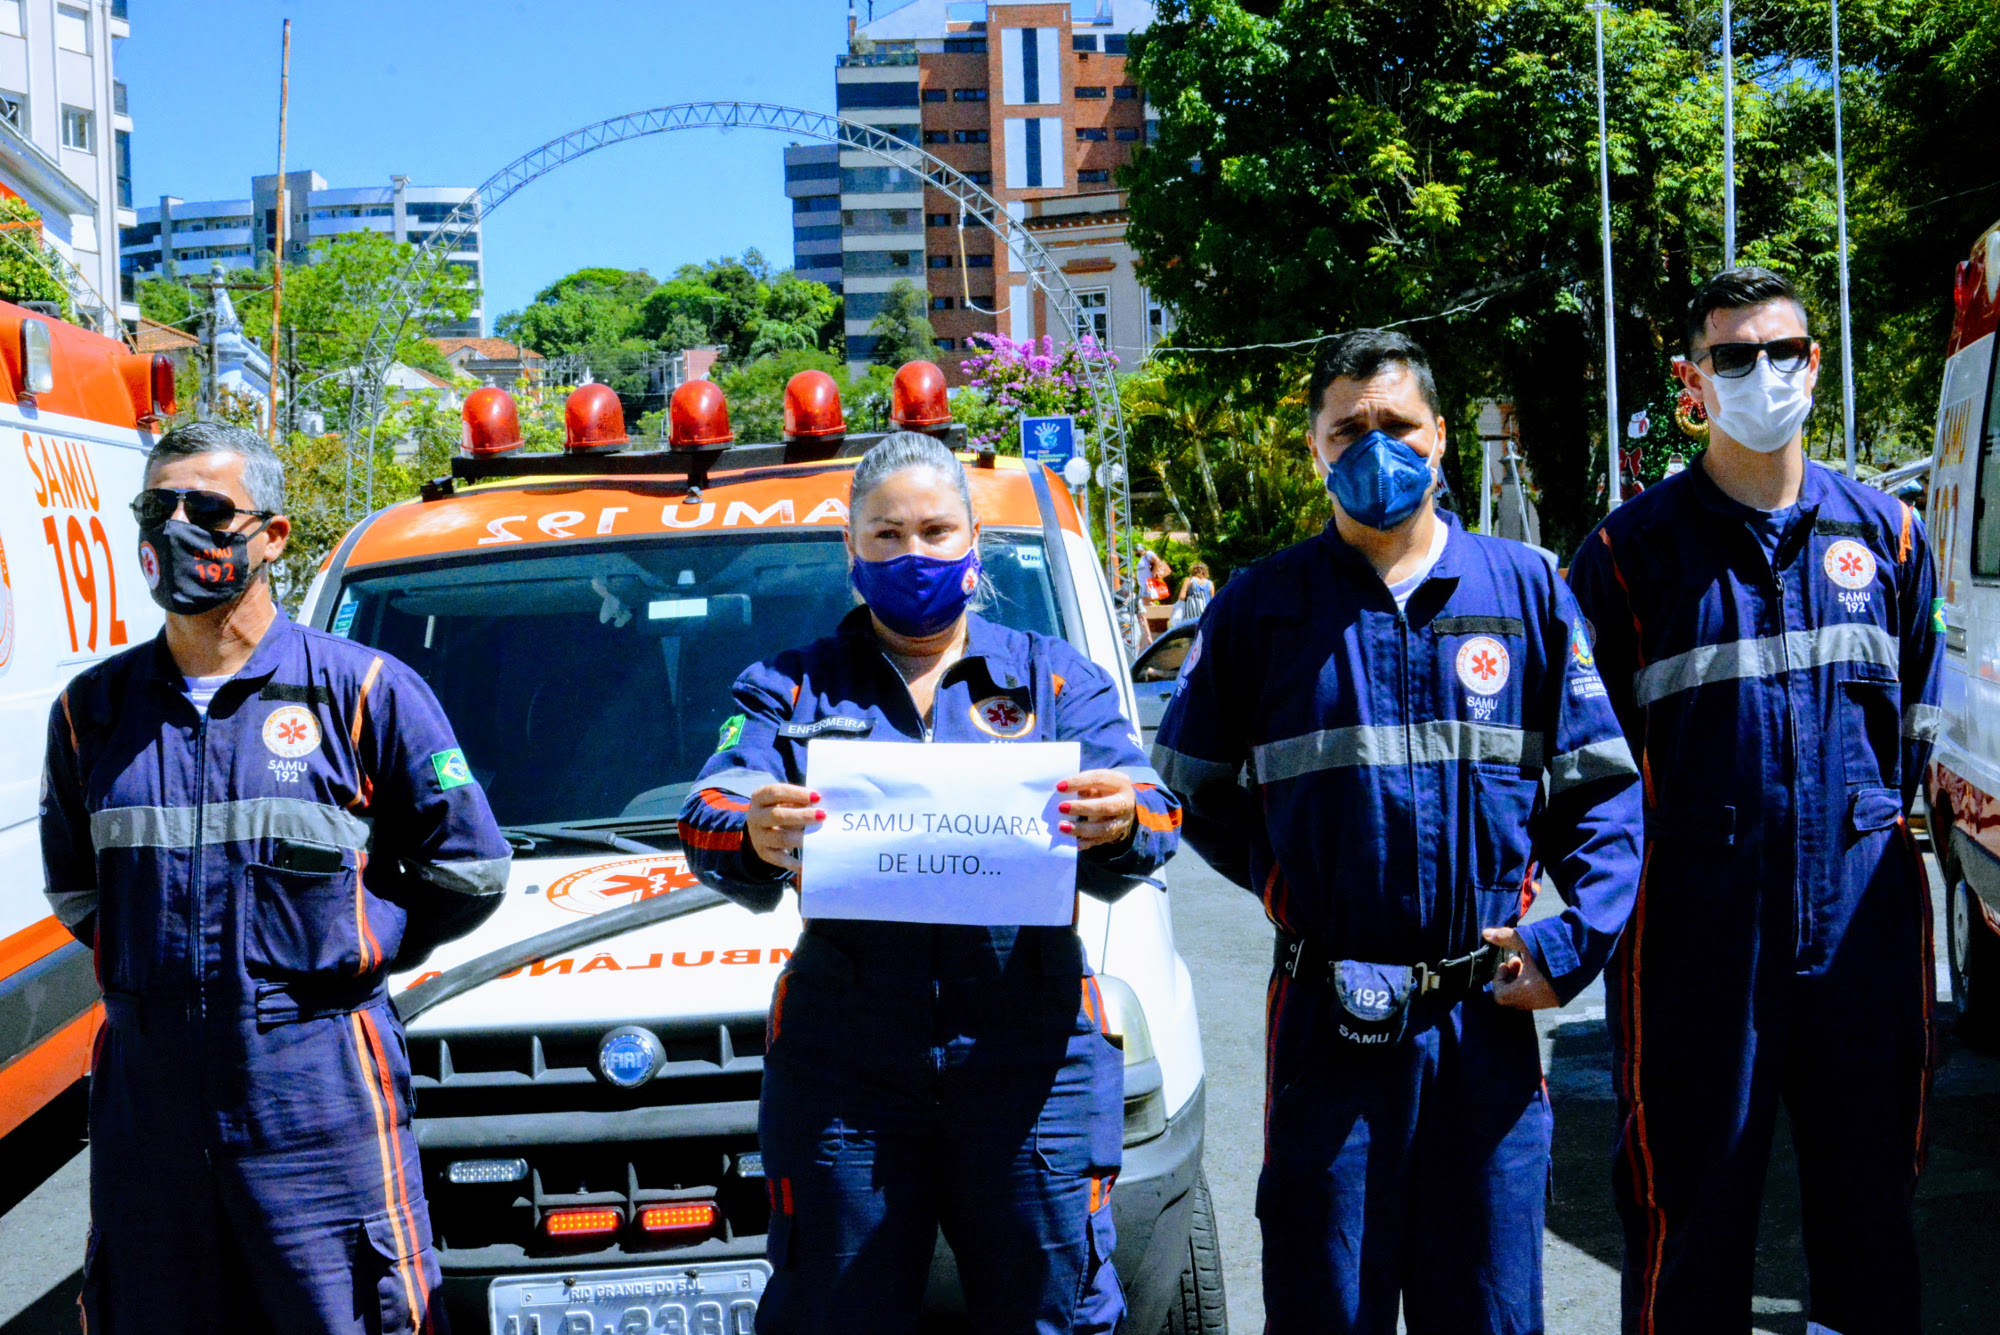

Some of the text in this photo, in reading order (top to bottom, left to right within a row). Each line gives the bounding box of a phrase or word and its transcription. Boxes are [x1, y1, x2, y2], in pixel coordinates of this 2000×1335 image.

[23, 431, 99, 512] SAMU
[194, 547, 233, 560] SAMU
[196, 563, 235, 582] 192
[43, 515, 128, 652] 192
[1838, 592, 1871, 602] SAMU
[1845, 602, 1866, 613] 192
[1467, 696, 1498, 710] SAMU
[1474, 708, 1491, 720] 192
[788, 717, 867, 735] ENFERMEIRA
[268, 759, 307, 772] SAMU
[274, 770, 299, 783] 192
[842, 812, 1040, 836] SAMU TAQUARA
[878, 853, 1001, 876] DE LUTO...
[1353, 988, 1389, 1010] 192
[1339, 1024, 1390, 1044] SAMU
[610, 1052, 645, 1069] FIAT
[570, 1278, 705, 1299] RIO GRANDE DO SUL
